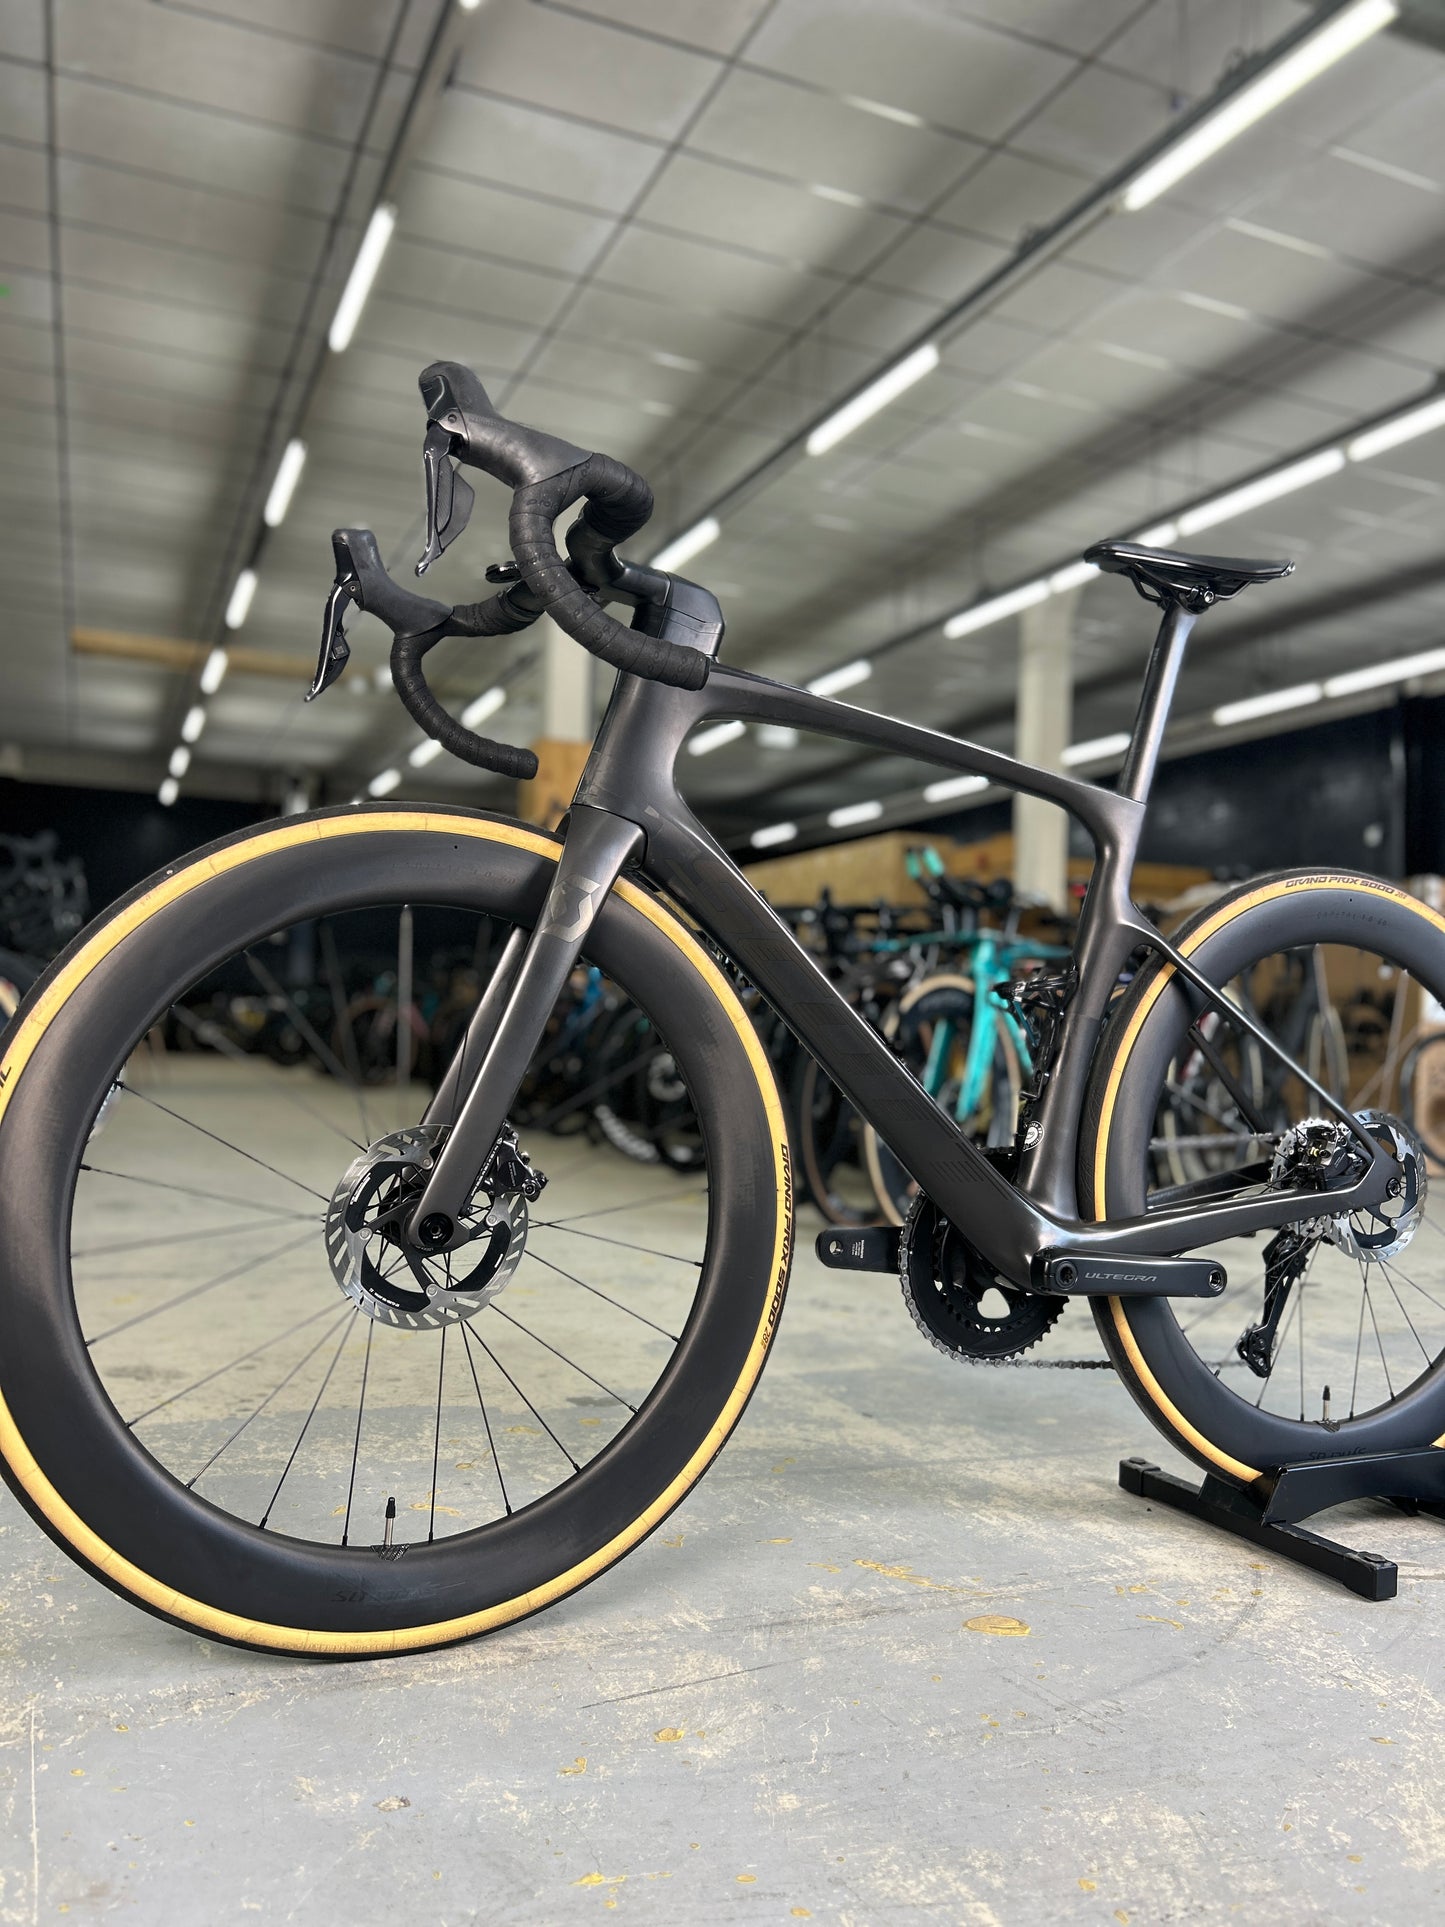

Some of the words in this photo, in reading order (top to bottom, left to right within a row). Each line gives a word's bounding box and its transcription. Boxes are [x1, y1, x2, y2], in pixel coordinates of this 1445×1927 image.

[1285, 876, 1328, 889] GRAND
[1328, 876, 1359, 885] PRIX
[1359, 880, 1394, 894] 5000
[781, 1143, 792, 1213] GRAND
[781, 1213, 792, 1267] PRIX
[767, 1266, 786, 1328] 5000
[1085, 1272, 1158, 1282] ULTEGRA
